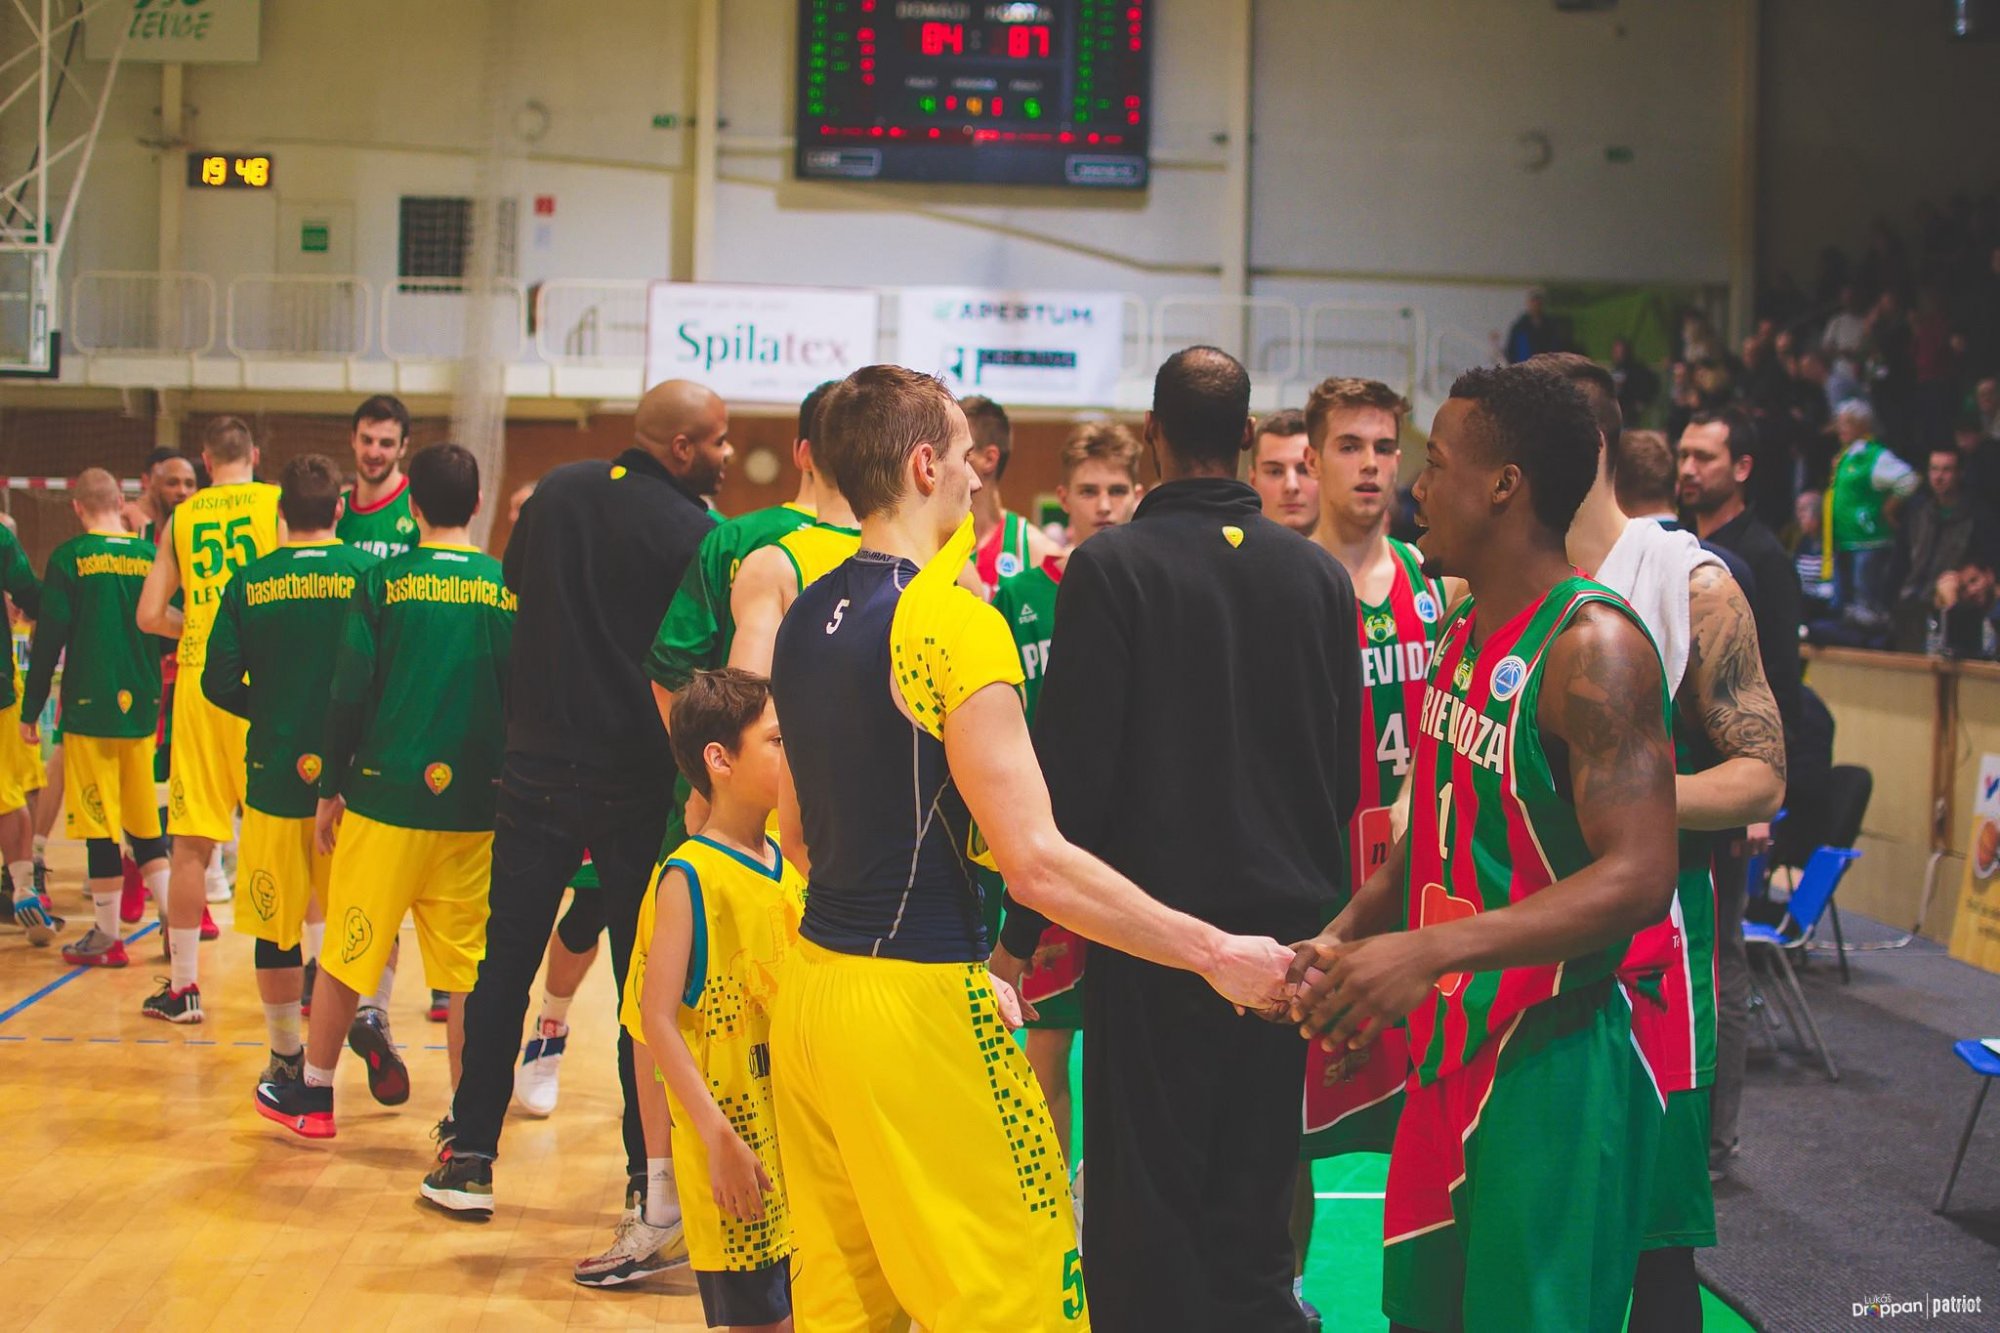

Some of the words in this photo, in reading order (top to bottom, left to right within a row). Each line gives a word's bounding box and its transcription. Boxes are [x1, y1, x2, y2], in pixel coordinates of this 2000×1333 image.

[922, 23, 963, 55] 84
[1008, 26, 1049, 57] 87
[202, 157, 226, 185] 19
[235, 157, 269, 186] 48
[961, 304, 1093, 324] APERTUM
[677, 322, 849, 370] Spilatex
[192, 517, 256, 578] 55
[826, 599, 850, 634] 5
[1377, 713, 1410, 776] 4
[1438, 782, 1453, 860] 1
[1063, 1247, 1084, 1320] 5
